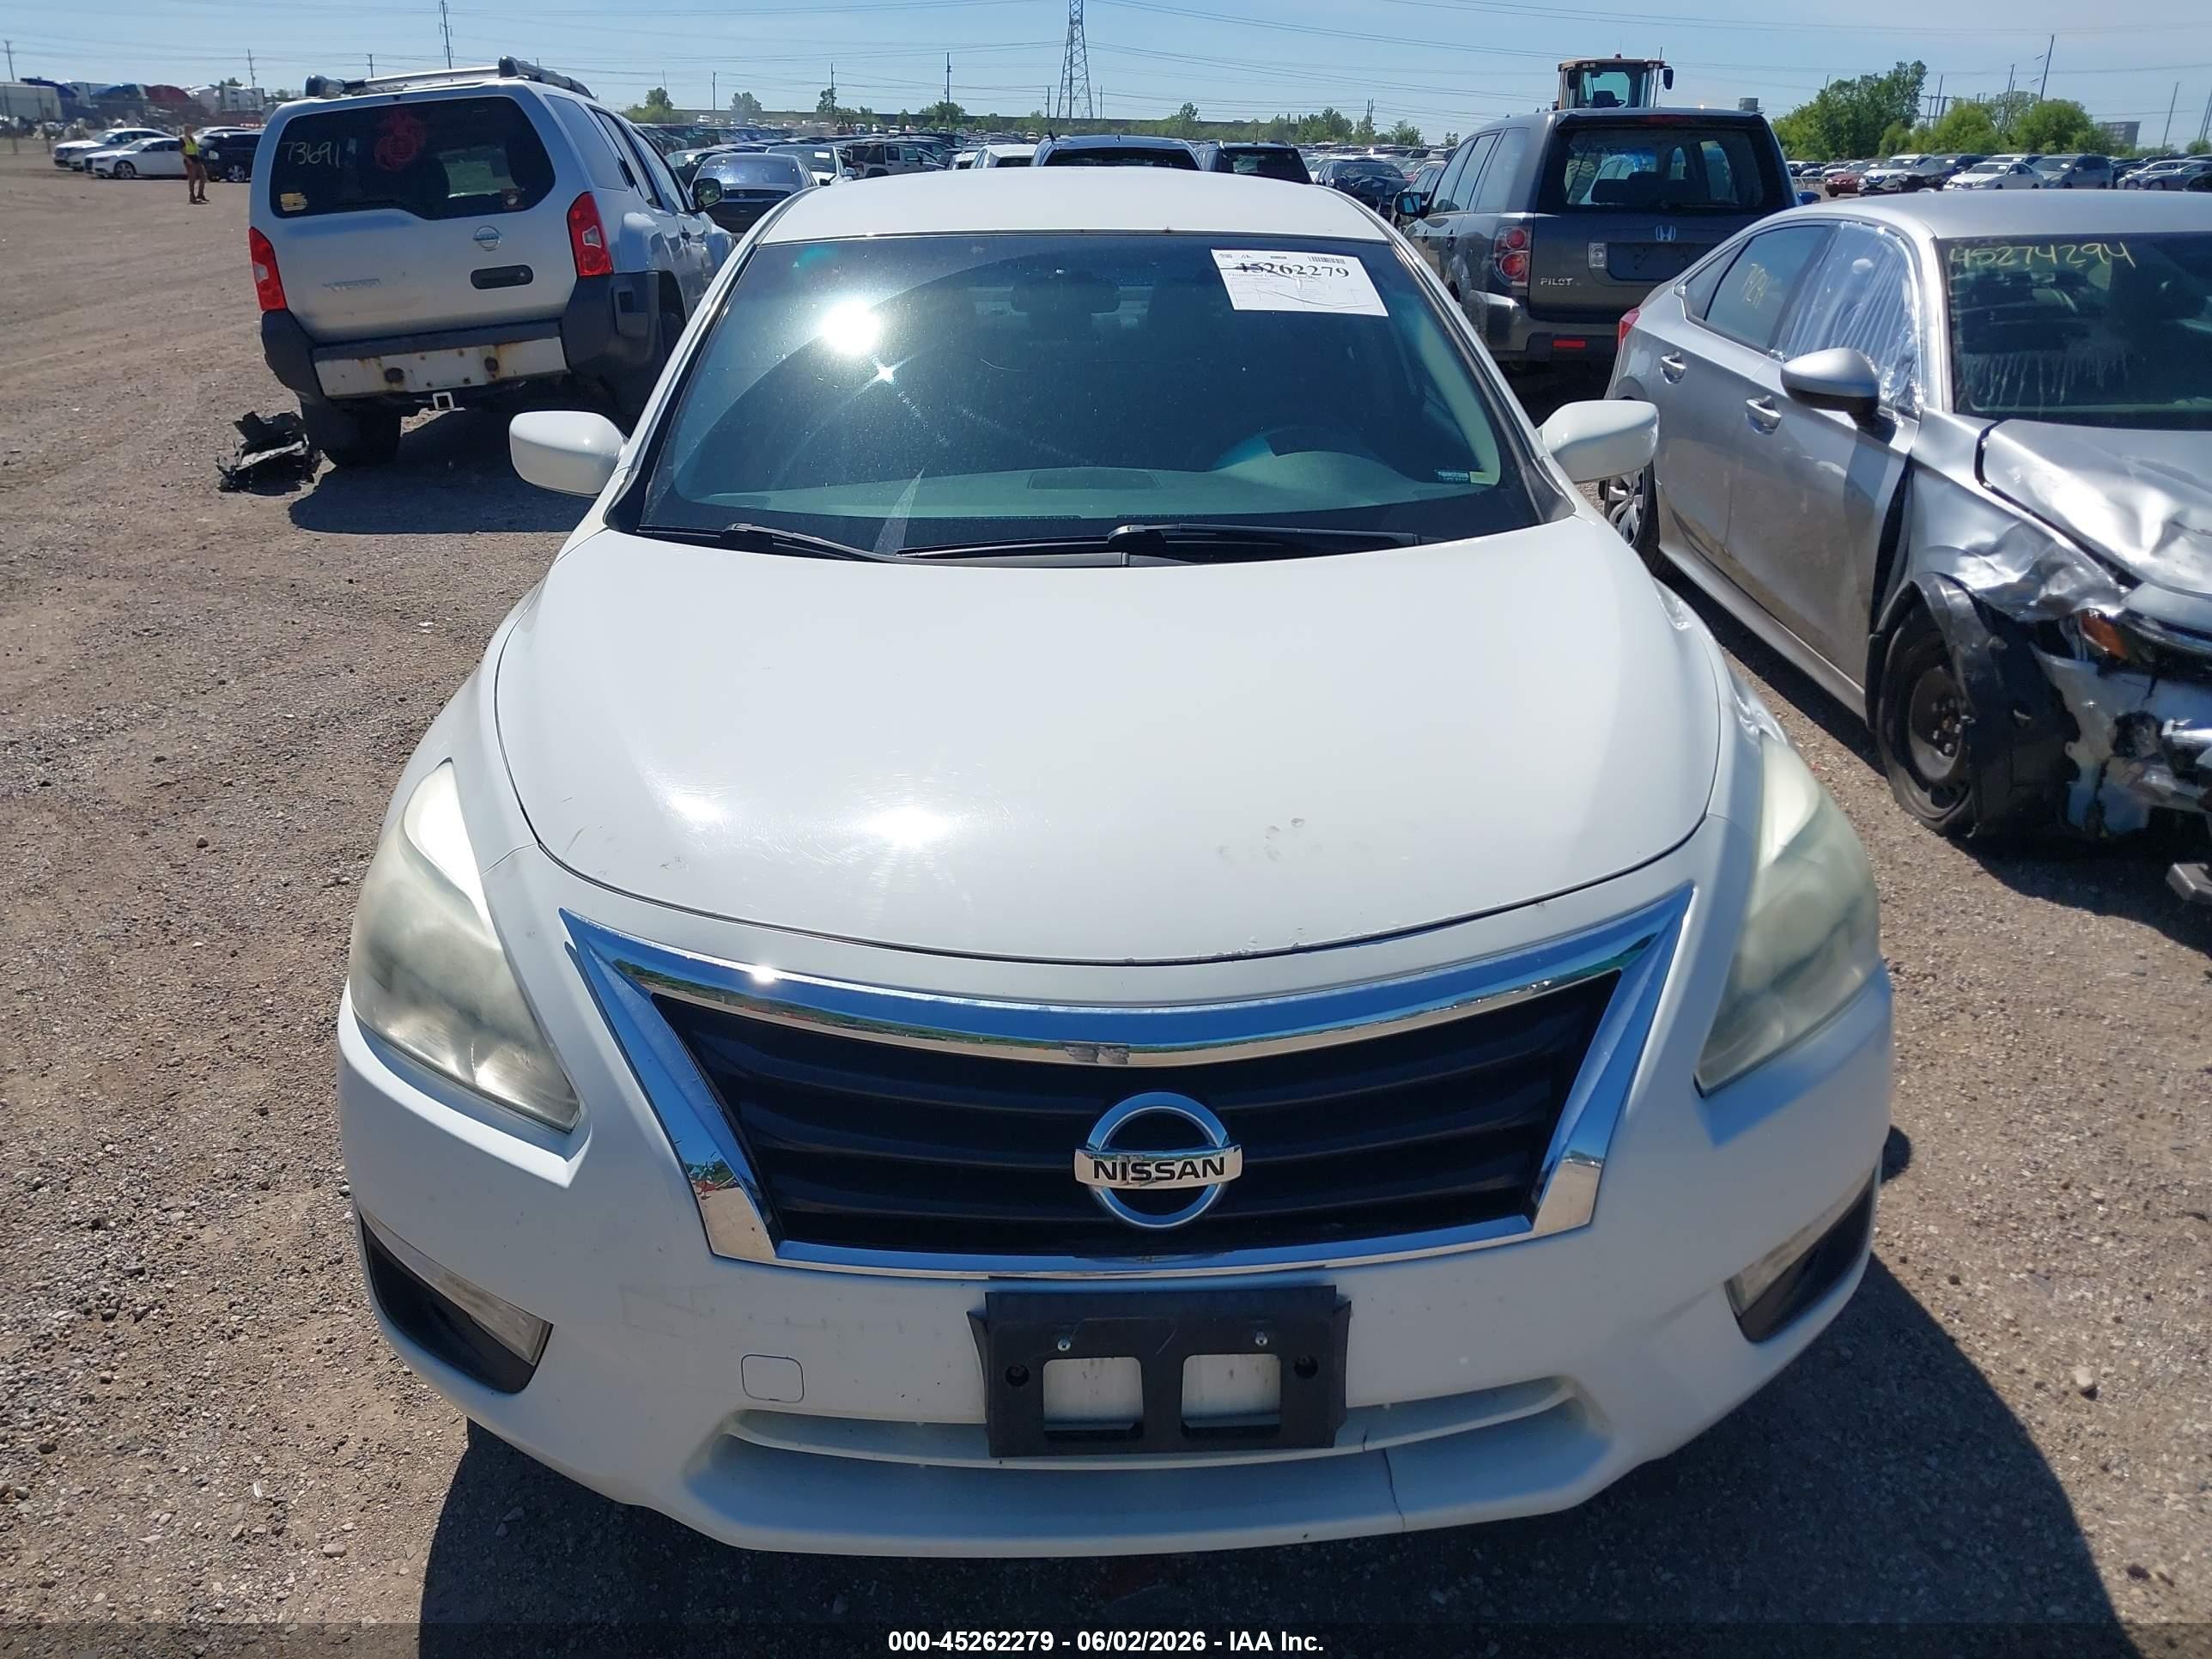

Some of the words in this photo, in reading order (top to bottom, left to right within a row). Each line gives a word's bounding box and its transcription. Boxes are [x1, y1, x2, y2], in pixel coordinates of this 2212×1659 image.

[283, 141, 342, 168] 73691
[1948, 241, 2136, 269] 45274294
[1237, 262, 1350, 278] 45262279
[1540, 277, 1573, 286] PILOT
[1093, 1157, 1225, 1182] NISSAN
